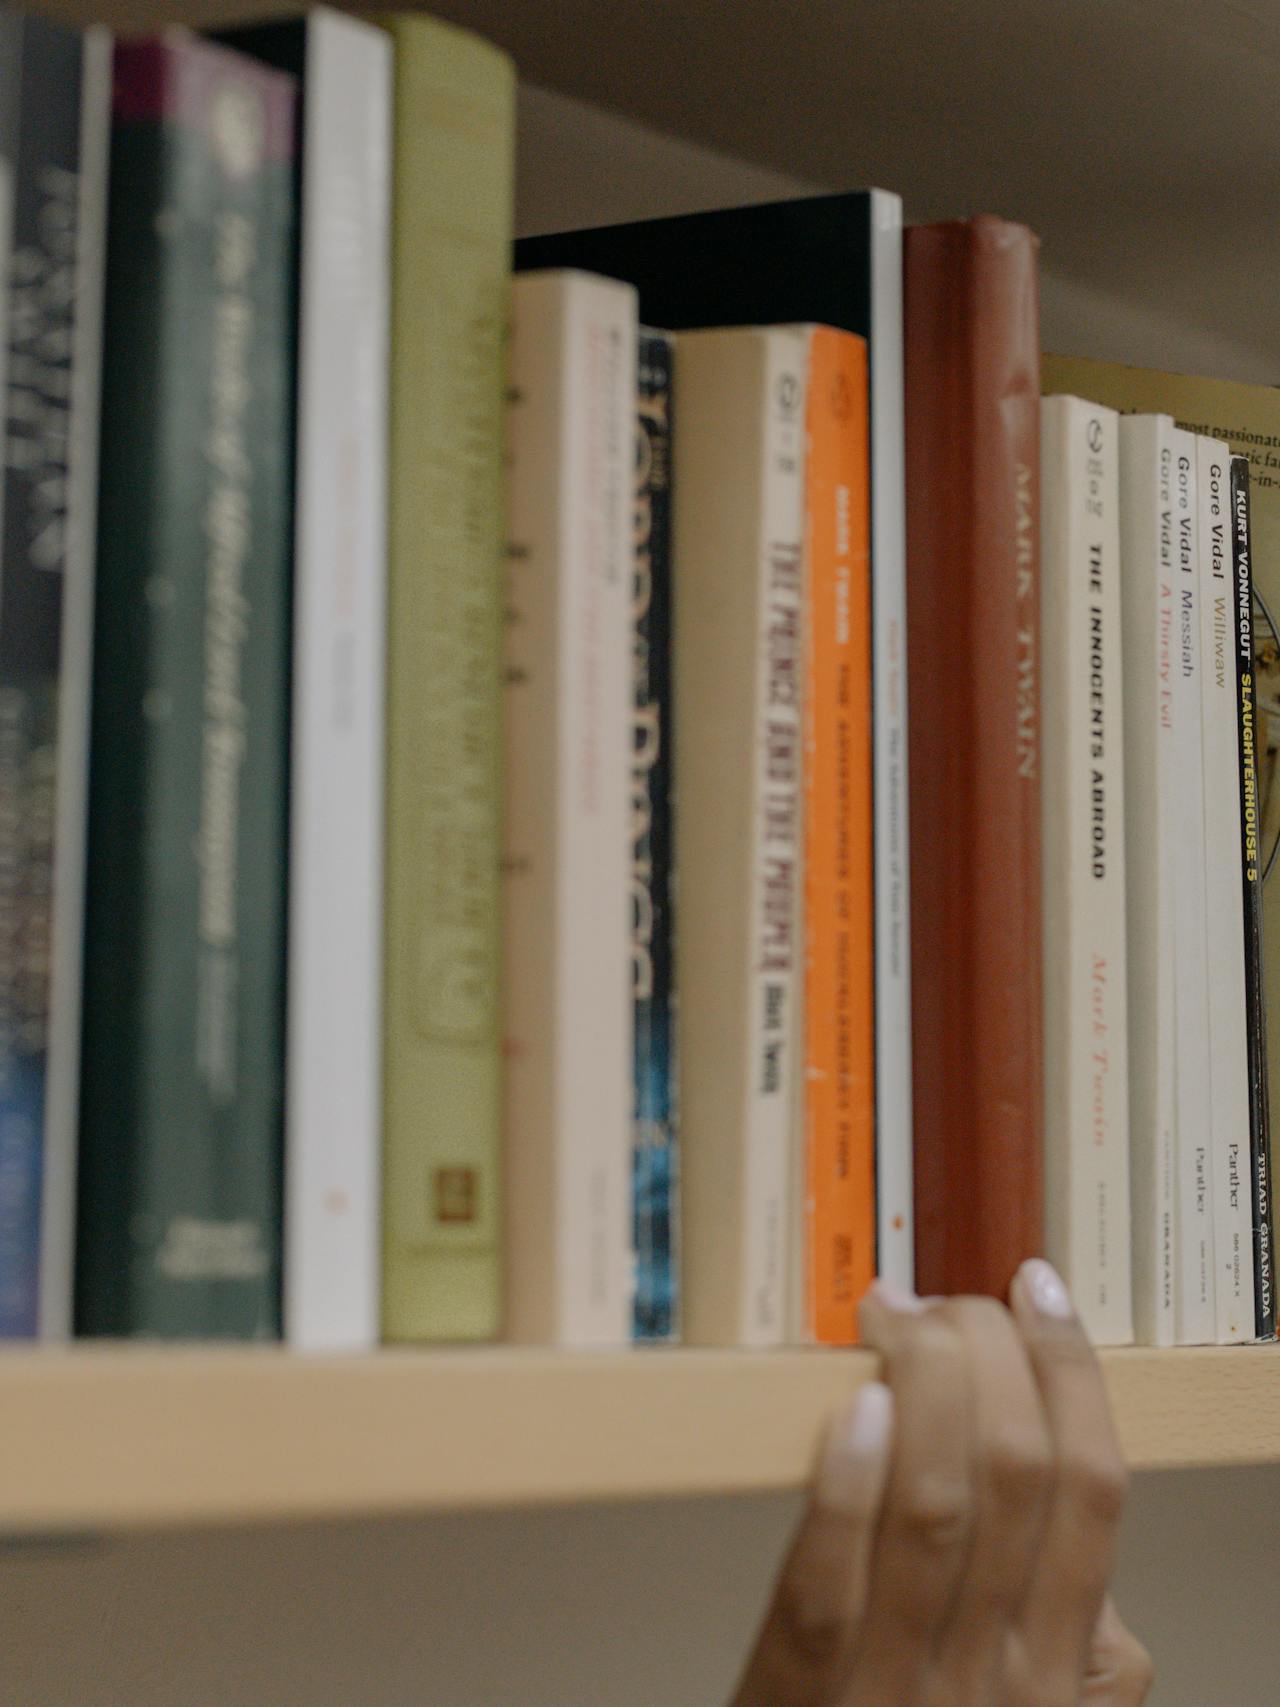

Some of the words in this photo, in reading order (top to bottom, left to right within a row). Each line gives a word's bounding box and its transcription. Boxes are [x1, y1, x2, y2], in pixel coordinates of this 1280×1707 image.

[1160, 447, 1171, 502] Gore
[1177, 456, 1190, 510] Gore
[1209, 463, 1223, 516] Gore
[1014, 463, 1033, 599] MARK
[1160, 511, 1172, 567] Vidal
[1179, 517, 1192, 573] Vidal
[1236, 489, 1248, 545] KURT
[1089, 542, 1103, 595] THE
[1211, 524, 1225, 580] Vidal
[1161, 582, 1171, 598] A
[1237, 551, 1251, 661] VONNEGUT
[1159, 607, 1172, 681] Thirsty
[1181, 589, 1195, 678] Messiah
[1213, 596, 1227, 689] Williwaw
[1017, 630, 1037, 780] TWAIN
[1089, 607, 1105, 759] INNOCENTS
[1160, 689, 1173, 729] Evil
[1241, 672, 1256, 862] SLAUGHTERHOUSE
[1091, 769, 1106, 881] ABROAD
[1246, 869, 1256, 882] 5
[1091, 952, 1109, 1039] Mark
[1090, 1049, 1109, 1148] Twain
[1195, 1147, 1207, 1216] Panther
[1228, 1143, 1241, 1211] Panther
[1257, 1153, 1267, 1214] TRIAD
[1260, 1222, 1271, 1319] GRANADA
